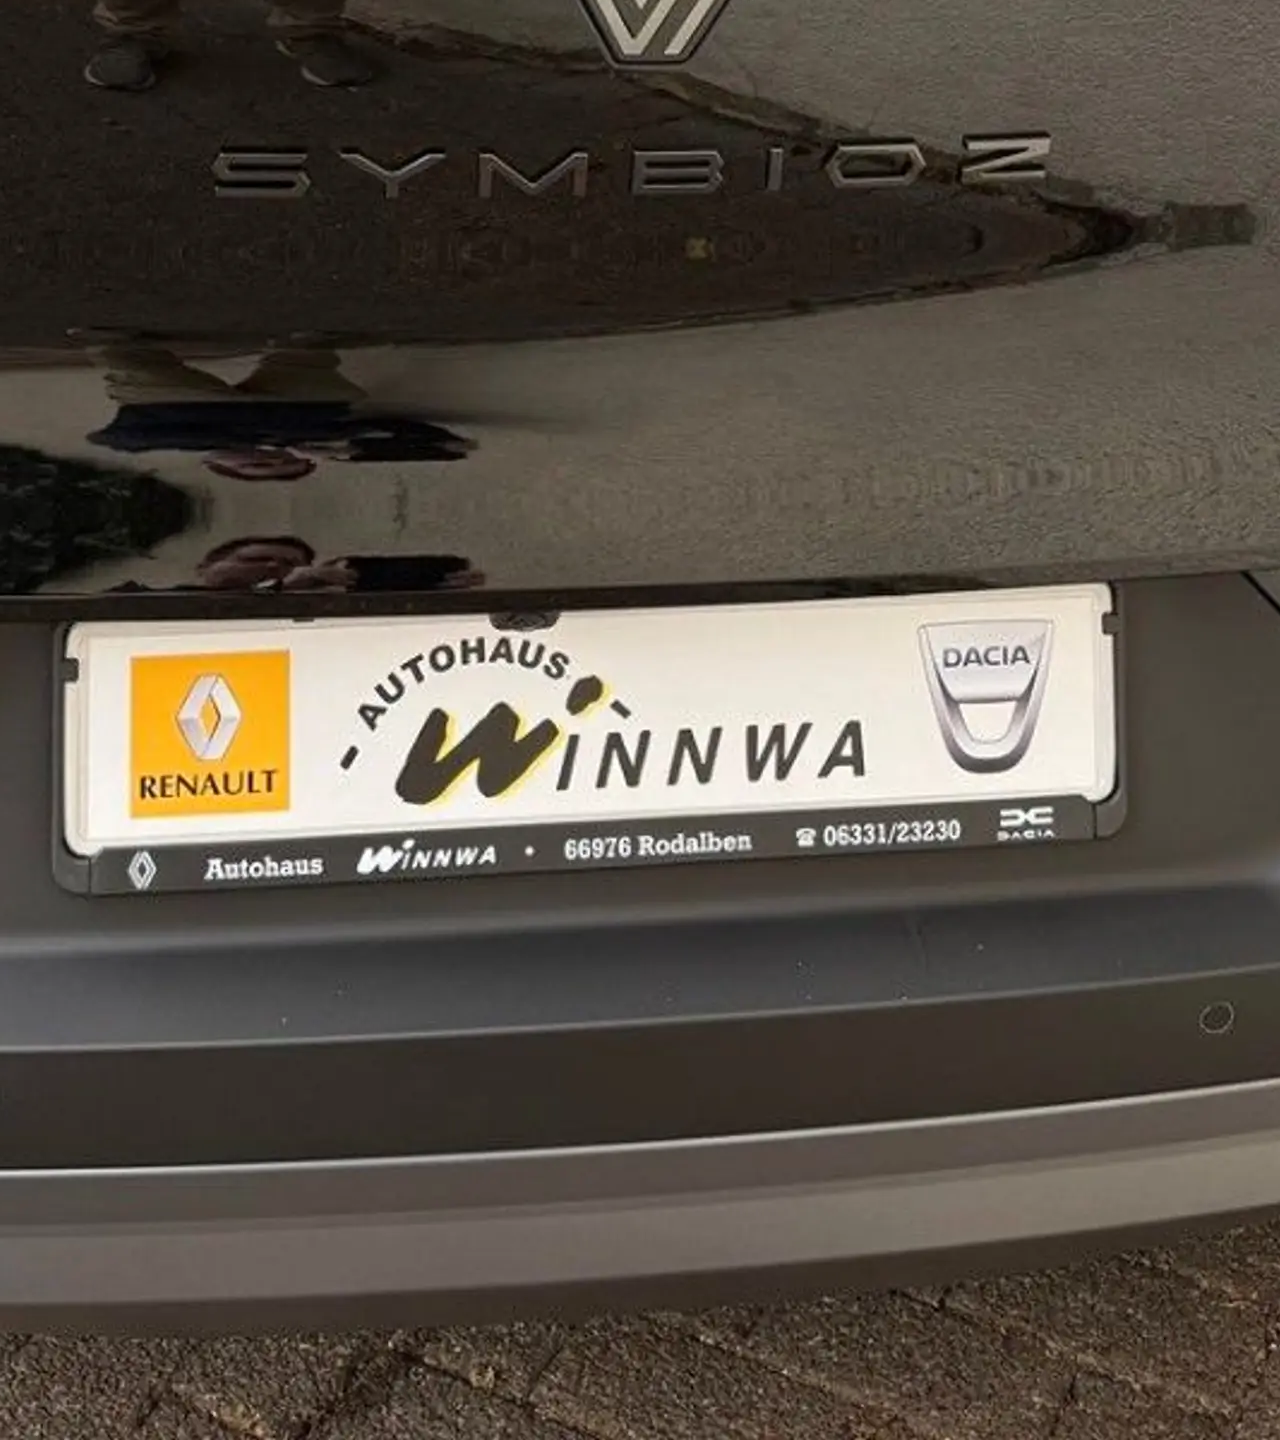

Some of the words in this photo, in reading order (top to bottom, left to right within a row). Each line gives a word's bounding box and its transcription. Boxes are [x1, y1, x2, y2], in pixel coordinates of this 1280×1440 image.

[211, 131, 1053, 198] SYMBIOZ
[942, 645, 1031, 668] DACIA
[358, 637, 569, 731] AUTOHAUS
[140, 770, 277, 799] RENAULT
[204, 857, 324, 880] Autohaus
[564, 836, 632, 860] 66976
[637, 832, 752, 857] Rodalben
[823, 819, 961, 846] 06331/23230
[997, 828, 1056, 842] DACIA
